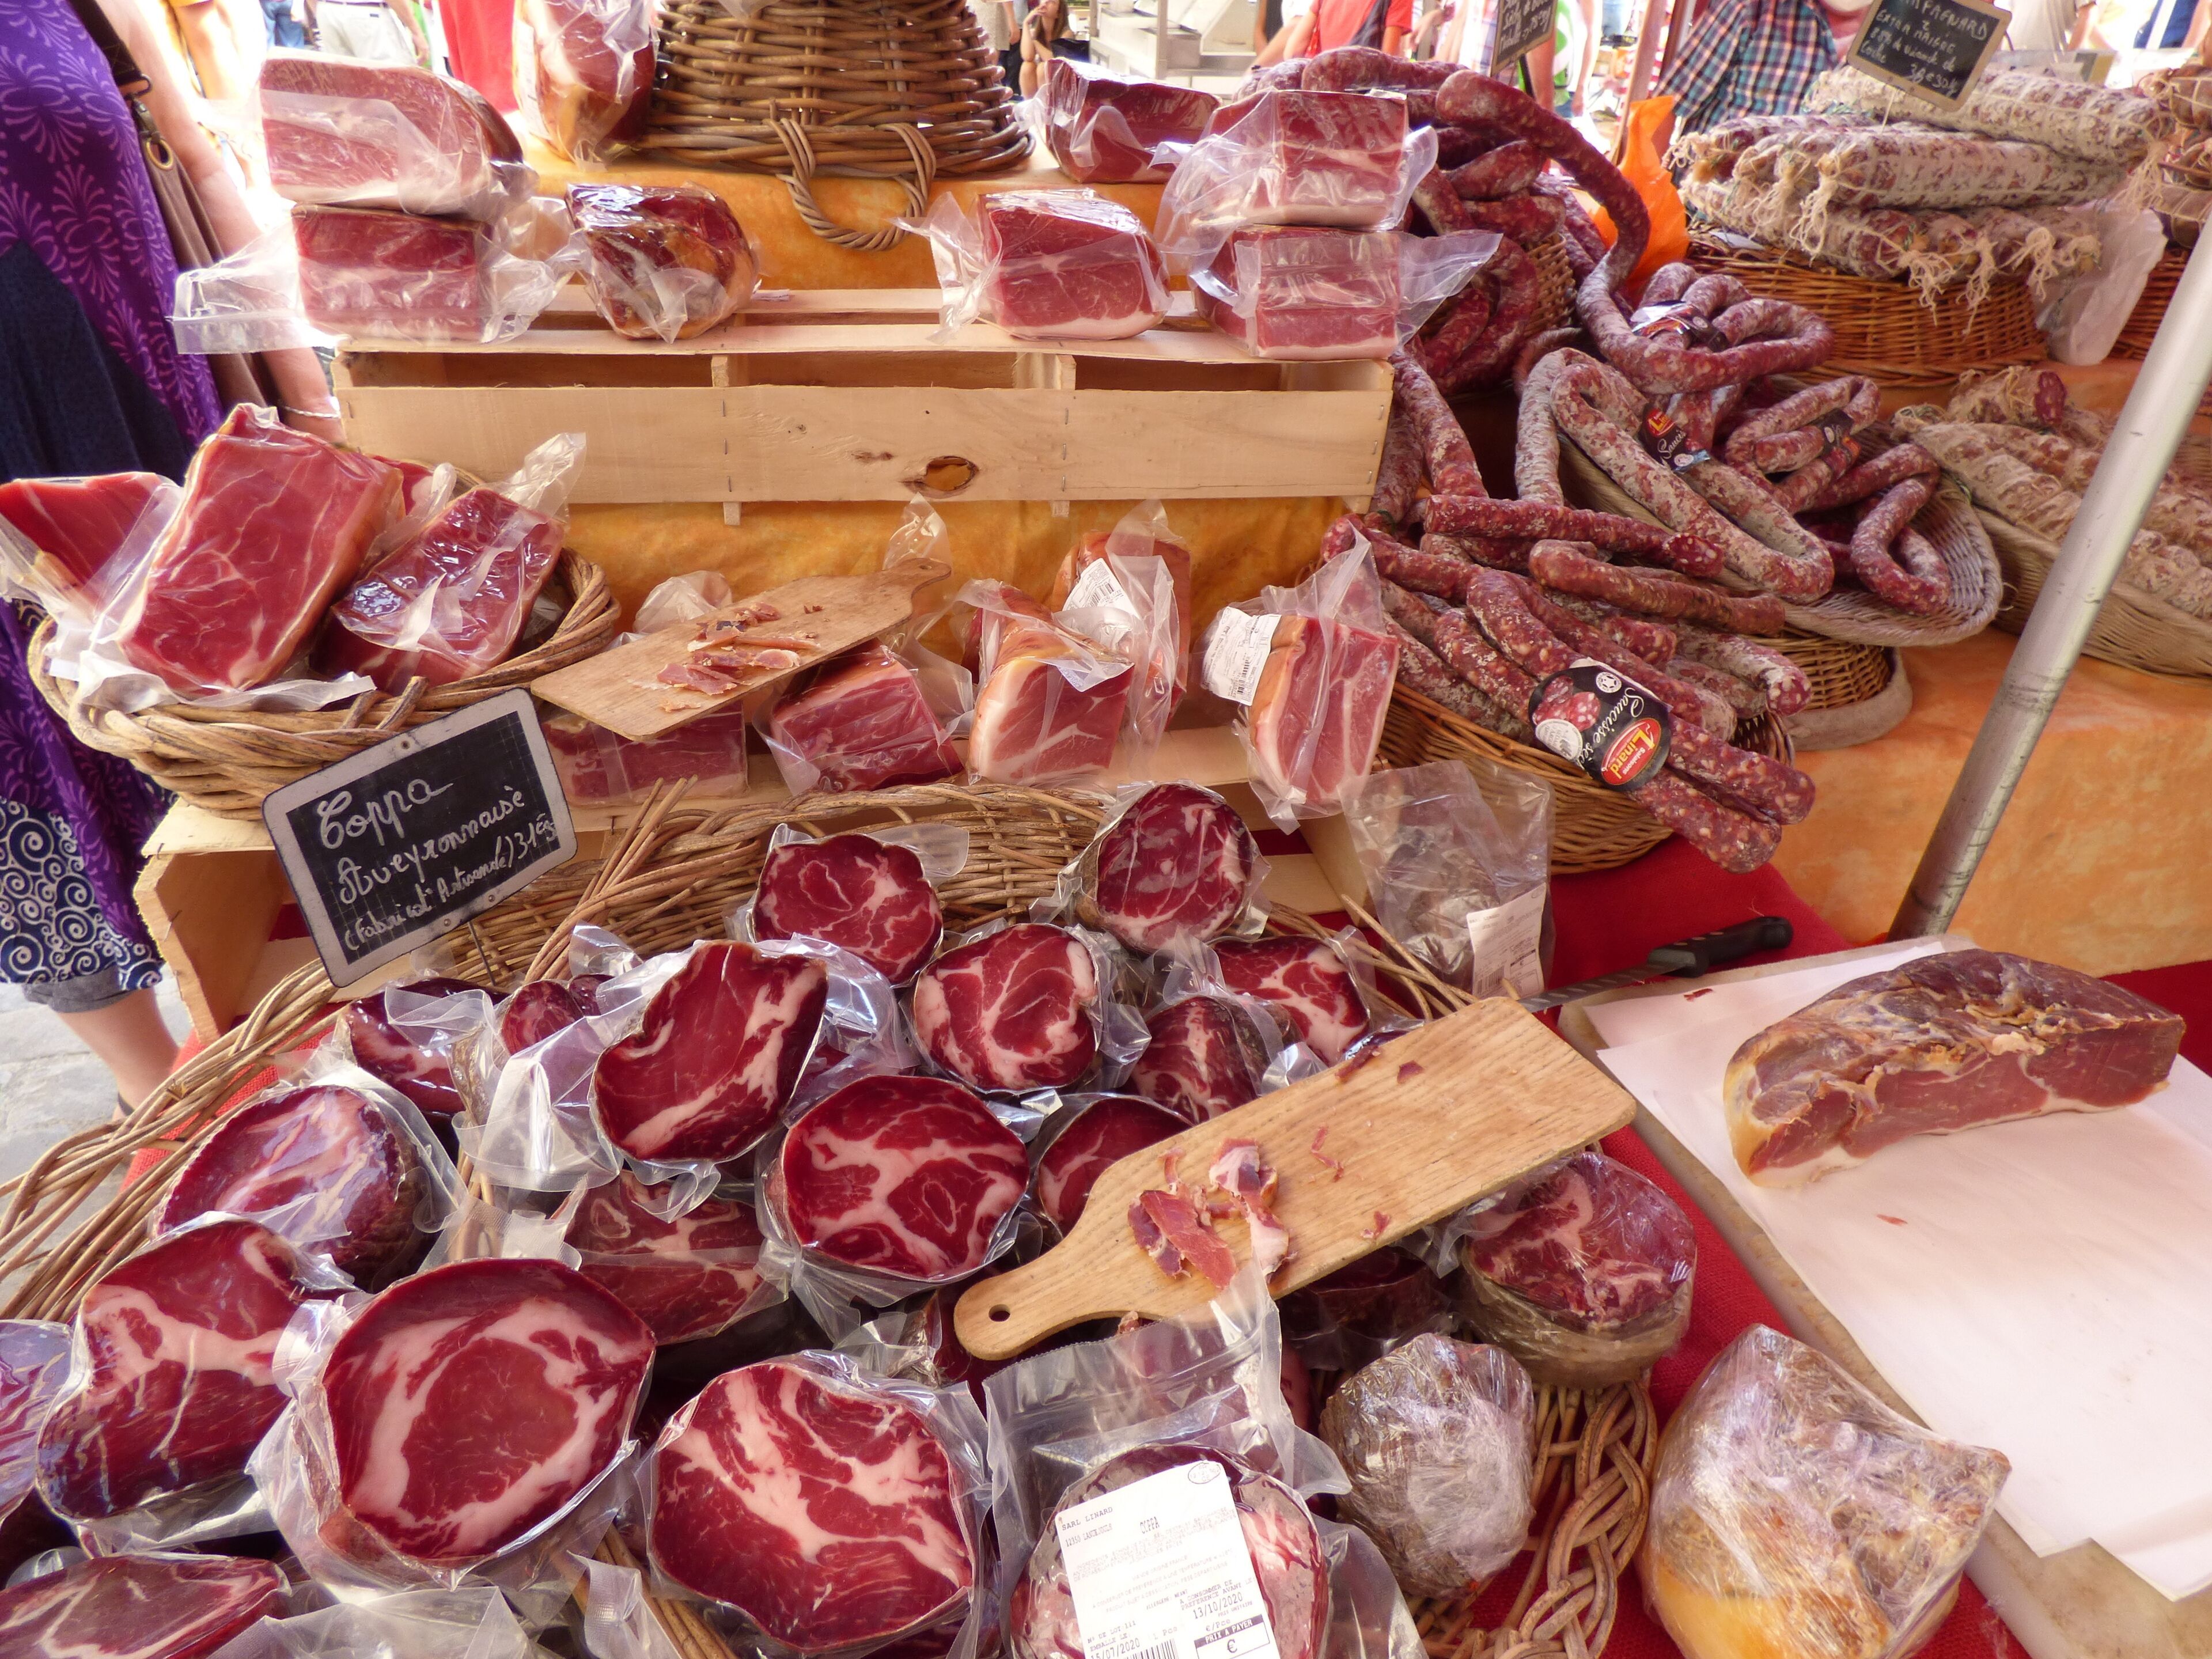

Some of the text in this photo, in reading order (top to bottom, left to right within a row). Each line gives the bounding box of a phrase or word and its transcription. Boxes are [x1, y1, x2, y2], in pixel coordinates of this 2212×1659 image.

[1593, 687, 1645, 743] Saucisse
[1609, 729, 1656, 779] Linard
[1622, 746, 1646, 775] Salaisons
[317, 778, 454, 849] Coppa
[1062, 1506, 1113, 1531] SARL LINARD
[1065, 1535, 1081, 1547] 12350
[1181, 1592, 1218, 1611] PREFERENCE
[1222, 1582, 1242, 1594] AVANT
[1187, 1584, 1221, 1601] CONSOMMER
[1193, 1592, 1243, 1619] 13/10/2020
[1205, 1619, 1253, 1645] PRIX A PAYER
[1226, 1638, 1238, 1654] €
